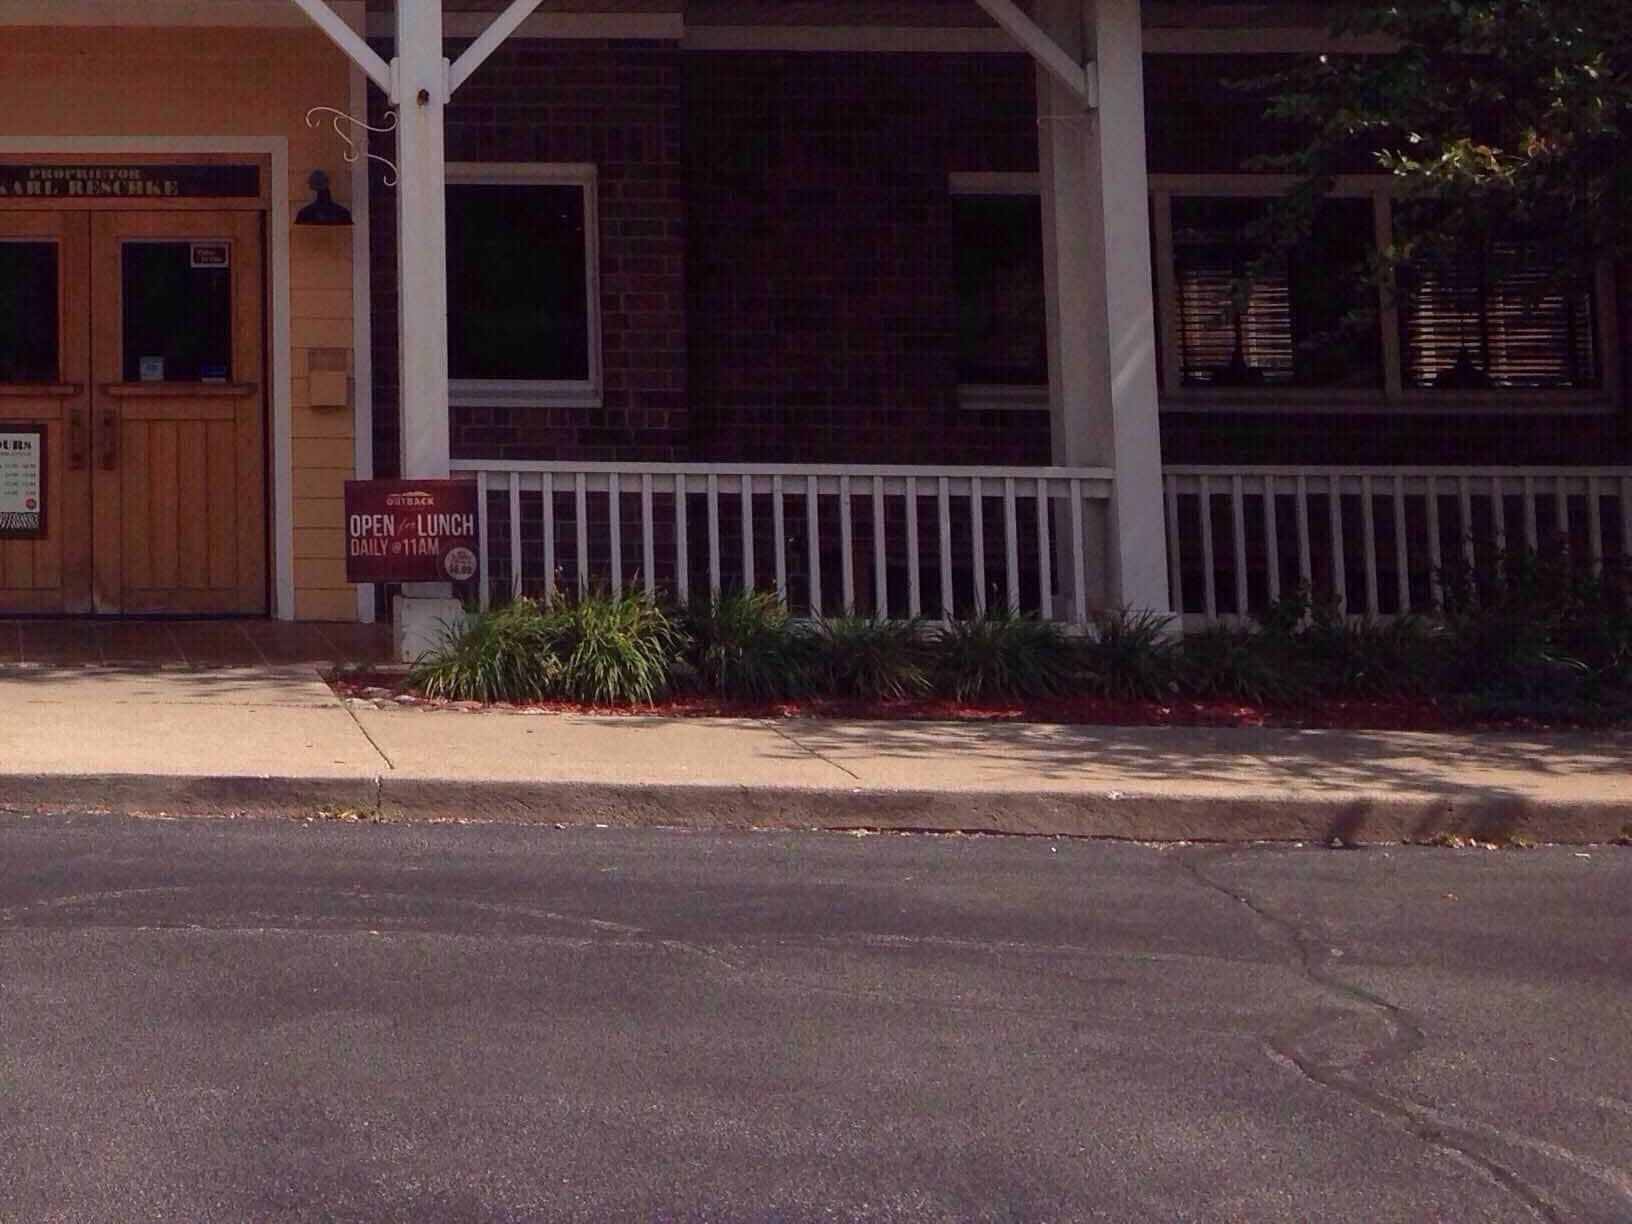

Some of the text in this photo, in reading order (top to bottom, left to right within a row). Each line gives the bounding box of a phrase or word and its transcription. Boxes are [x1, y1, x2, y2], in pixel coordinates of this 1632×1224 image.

[68, 180, 179, 196] RESCHKE
[385, 497, 435, 506] OUTBACK
[349, 514, 395, 537] OPEN
[417, 513, 474, 537] LUNCH
[350, 538, 389, 556] DAILY
